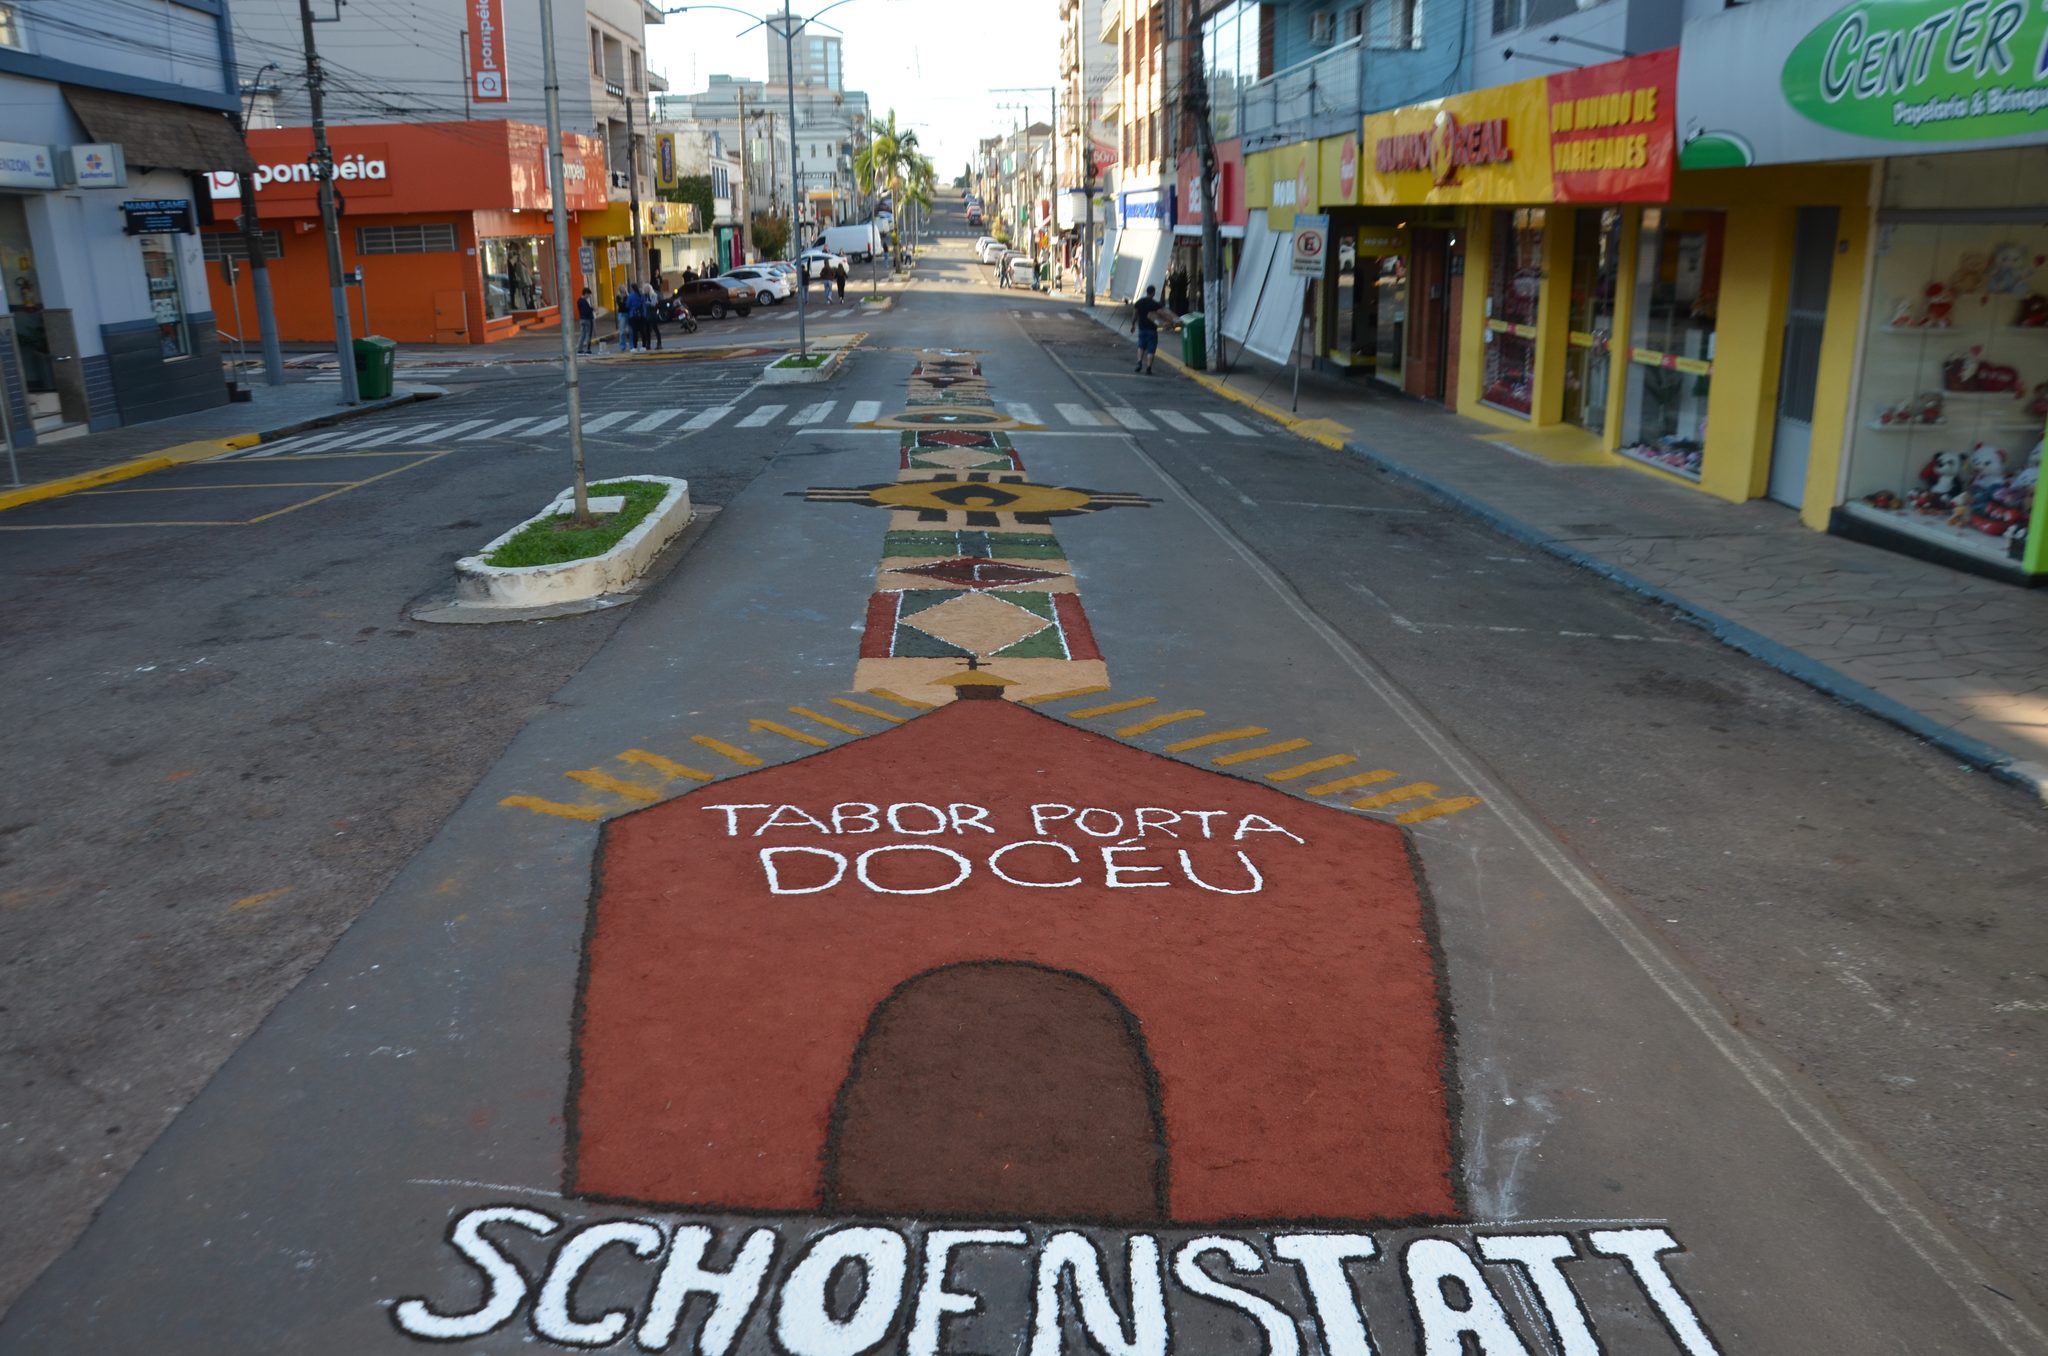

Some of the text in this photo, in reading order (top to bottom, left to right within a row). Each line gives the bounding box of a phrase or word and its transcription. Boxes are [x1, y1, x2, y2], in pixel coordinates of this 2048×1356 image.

[1820, 0, 2028, 104] CENTER
[1893, 97, 1968, 127] Papelaria
[1553, 133, 1648, 173] VARIEDADES
[702, 803, 1305, 844] TABOR PORTA
